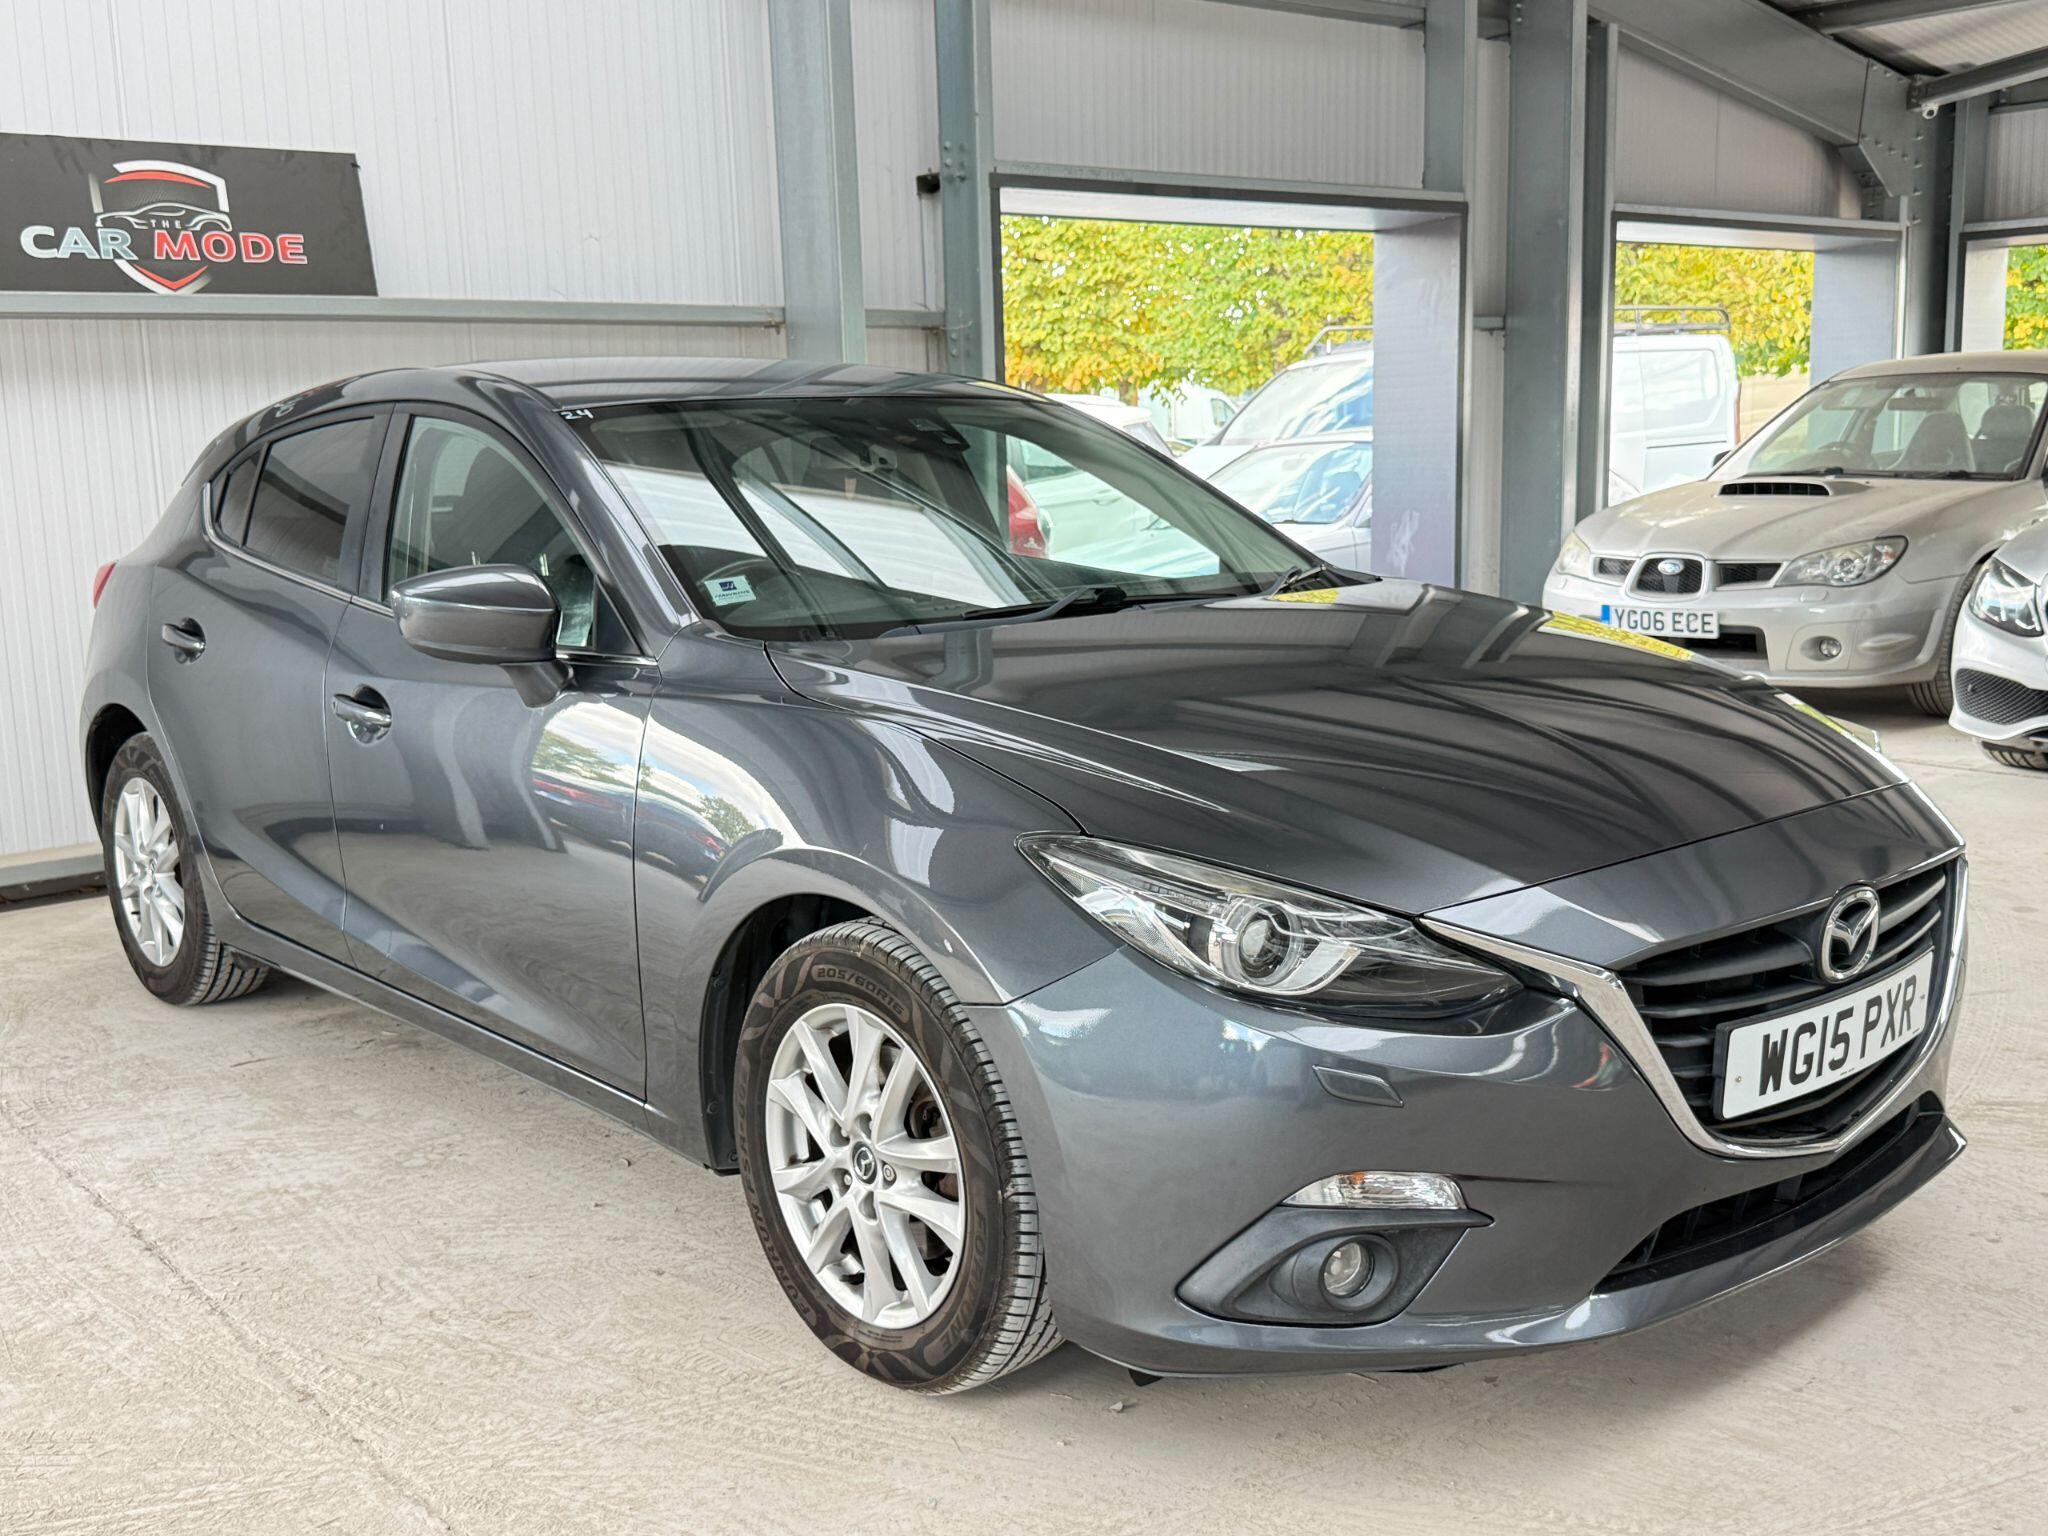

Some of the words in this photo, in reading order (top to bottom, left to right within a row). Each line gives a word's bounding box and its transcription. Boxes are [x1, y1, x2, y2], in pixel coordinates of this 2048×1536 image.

[151, 219, 181, 228] THE
[20, 226, 139, 260] CAR
[154, 230, 308, 264] MODE
[560, 409, 594, 420] 24
[1614, 608, 1665, 631] YG06
[1671, 612, 1714, 633] ECE
[816, 966, 905, 1017] 205/60R16
[1758, 1006, 1854, 1097] WG15
[1859, 974, 1917, 1060] PXR
